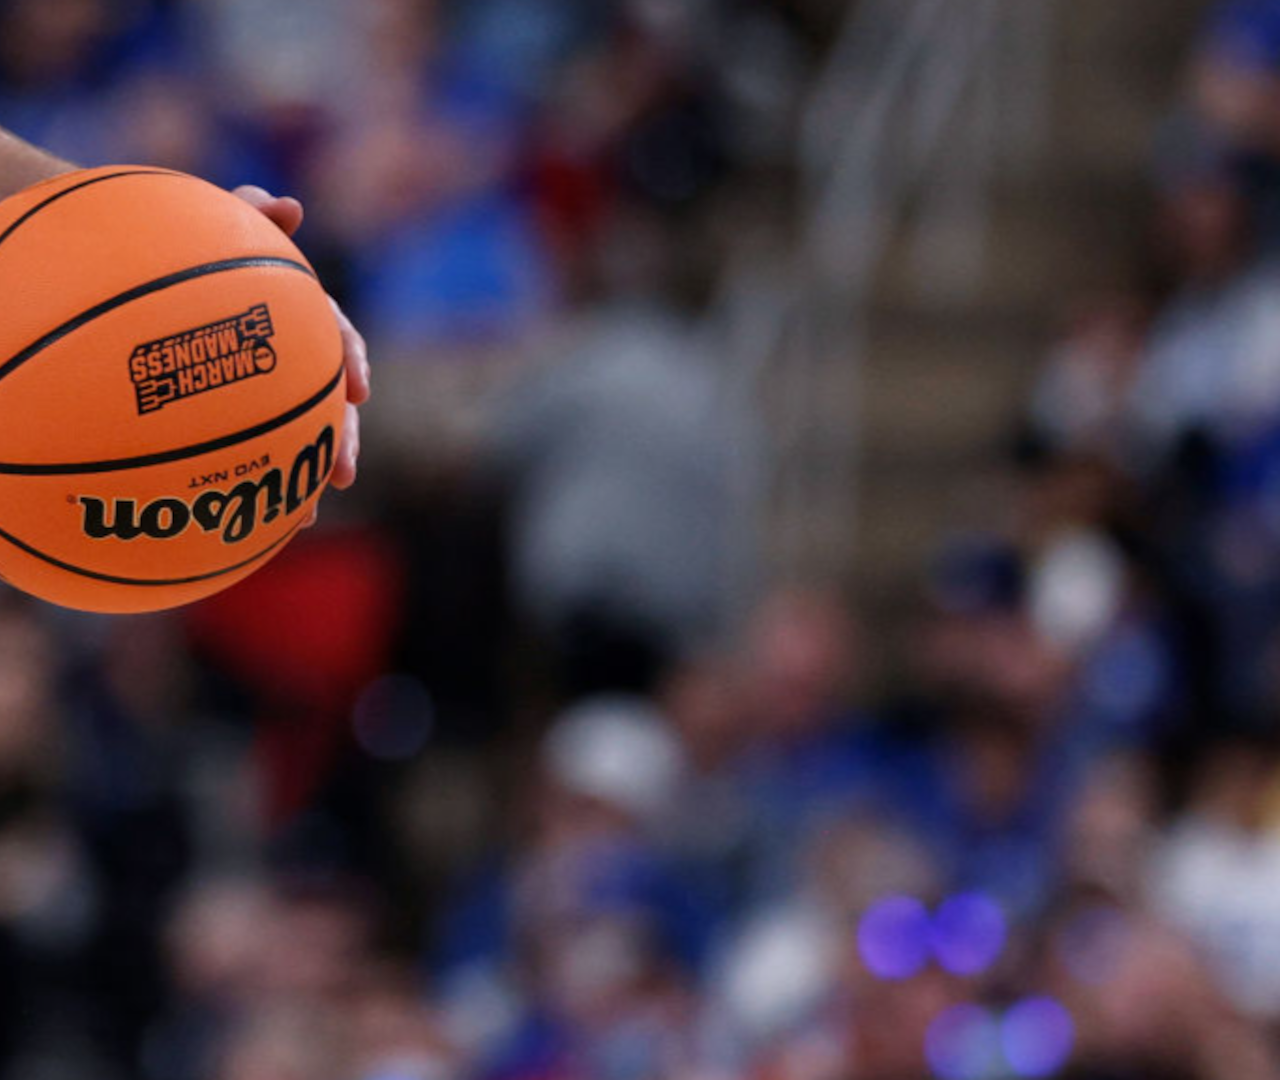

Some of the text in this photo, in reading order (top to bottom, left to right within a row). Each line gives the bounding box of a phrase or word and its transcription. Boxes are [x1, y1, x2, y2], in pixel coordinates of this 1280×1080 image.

[131, 327, 239, 382] MADNESS
[178, 349, 255, 395] MARCH
[79, 424, 334, 544] Wilson
[187, 454, 270, 489] EVO NXT
